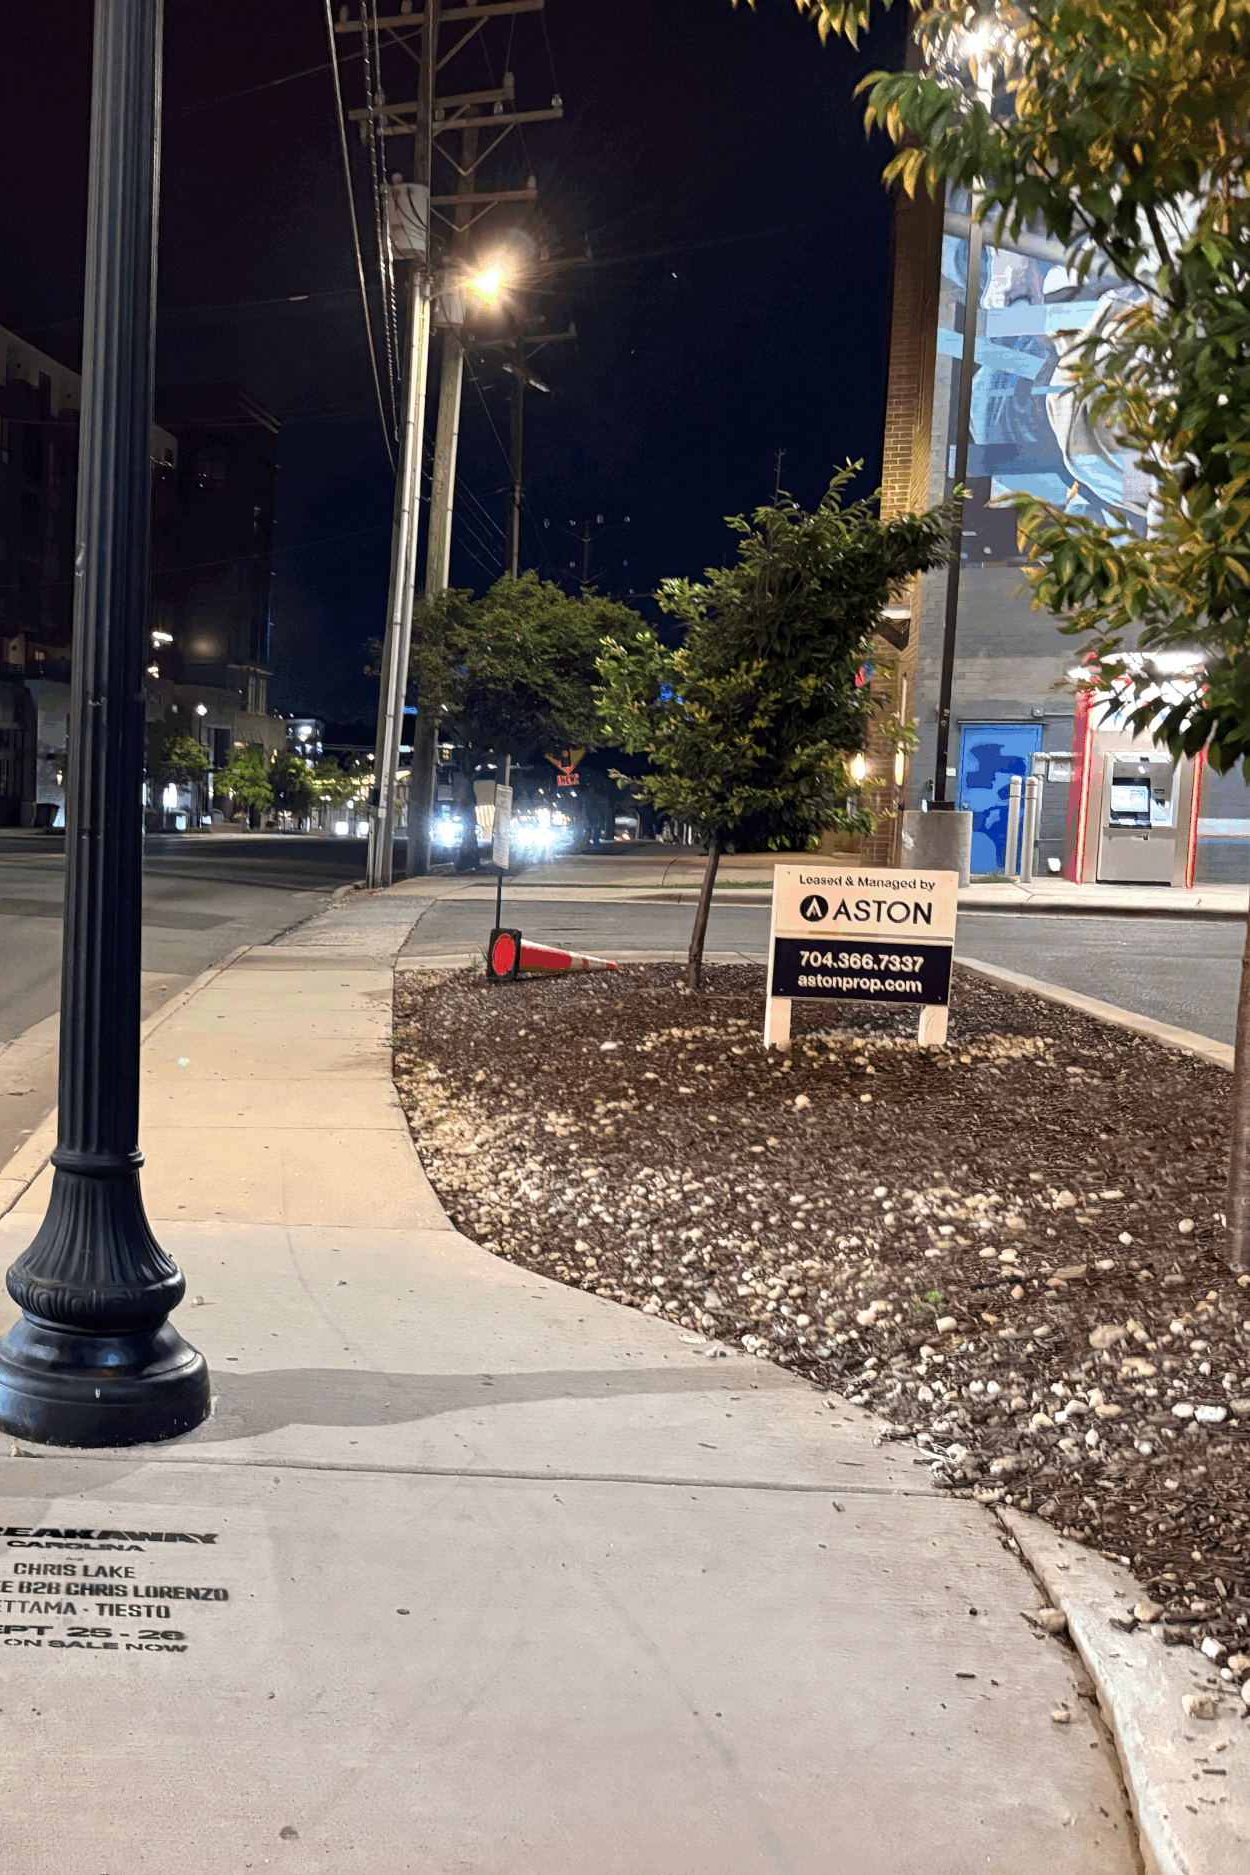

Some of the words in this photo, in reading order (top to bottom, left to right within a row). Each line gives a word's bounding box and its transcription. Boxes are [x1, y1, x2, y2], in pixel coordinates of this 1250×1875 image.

[799, 874, 842, 886] Leased
[845, 875, 854, 886] &
[857, 877, 916, 891] Managed
[920, 878, 935, 892] by
[832, 898, 932, 925] ASTON
[800, 950, 924, 973] 704.366.7337
[797, 973, 923, 993] astonprop.com
[6, 1540, 145, 1552] CAROLINA
[13, 1562, 77, 1577] CHRIS
[83, 1564, 136, 1579] LAKE
[18, 1580, 61, 1595] B2B
[65, 1583, 128, 1598] CHRIS
[133, 1584, 228, 1601] LORENZO
[95, 1602, 171, 1618] TIESTO
[66, 1626, 113, 1638] 25
[6, 1638, 42, 1648] ON
[48, 1640, 119, 1650] SALE
[125, 1642, 188, 1653] NOW
